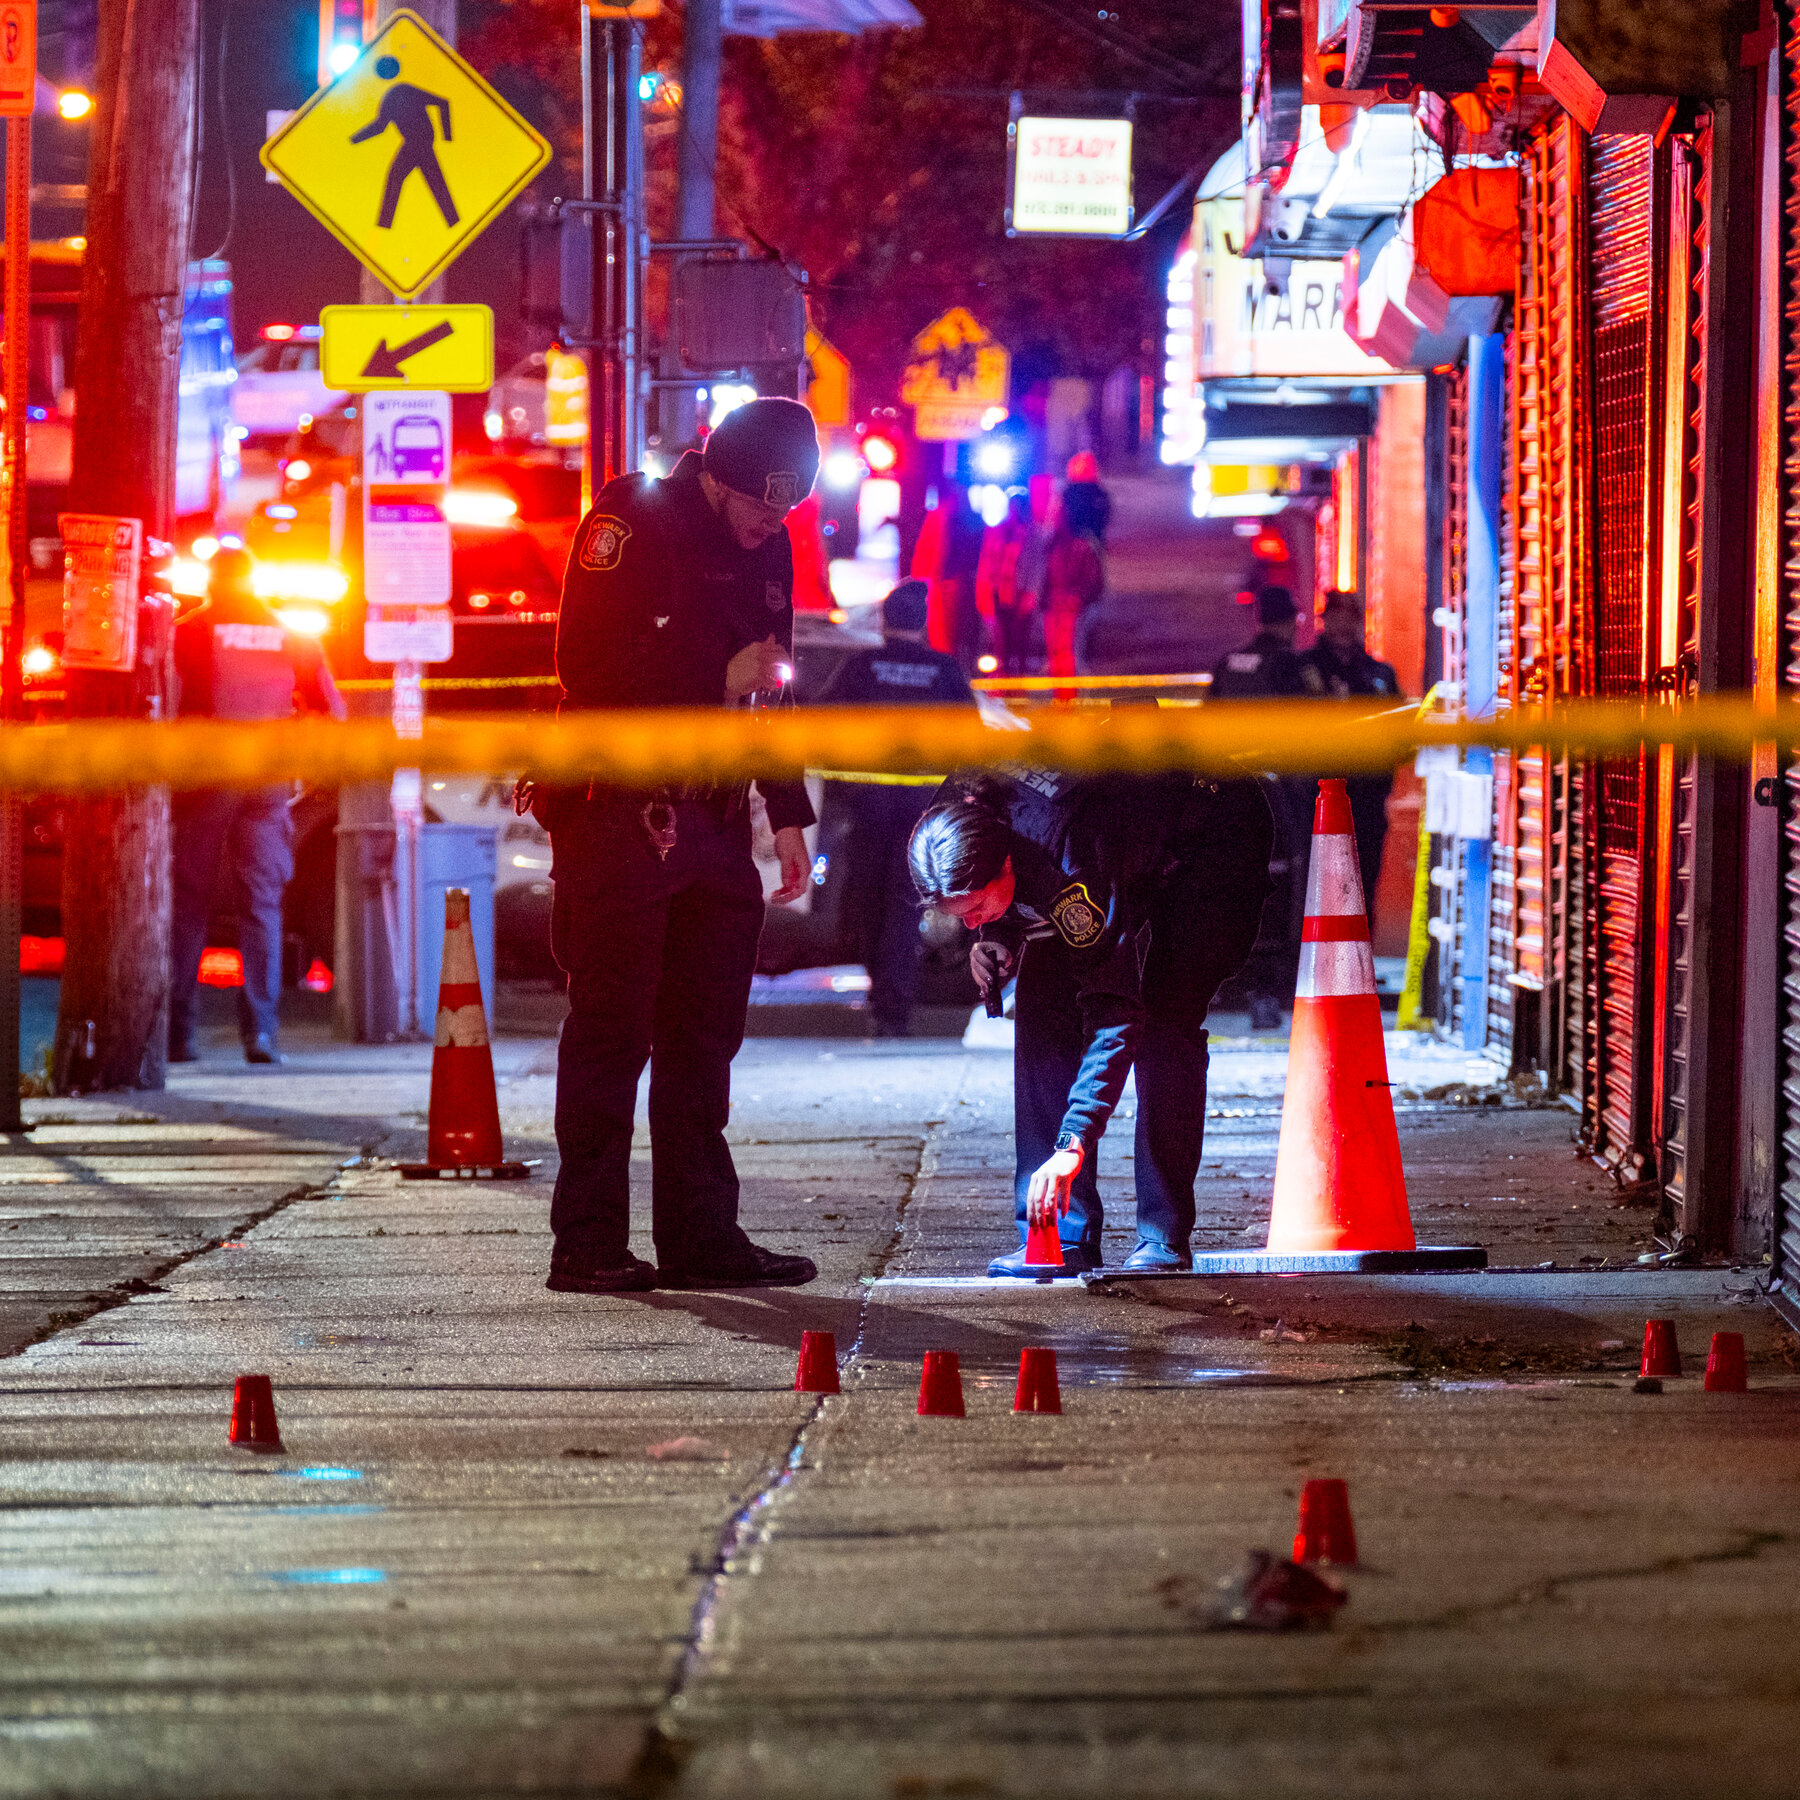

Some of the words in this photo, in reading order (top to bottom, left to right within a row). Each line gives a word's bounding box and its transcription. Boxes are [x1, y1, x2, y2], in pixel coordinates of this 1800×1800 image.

[1031, 136, 1117, 158] STEADY
[592, 521, 625, 538] NEWARK
[583, 553, 609, 566] POLICE
[1053, 892, 1083, 918] NEWARK
[1072, 921, 1101, 943] POLICE
